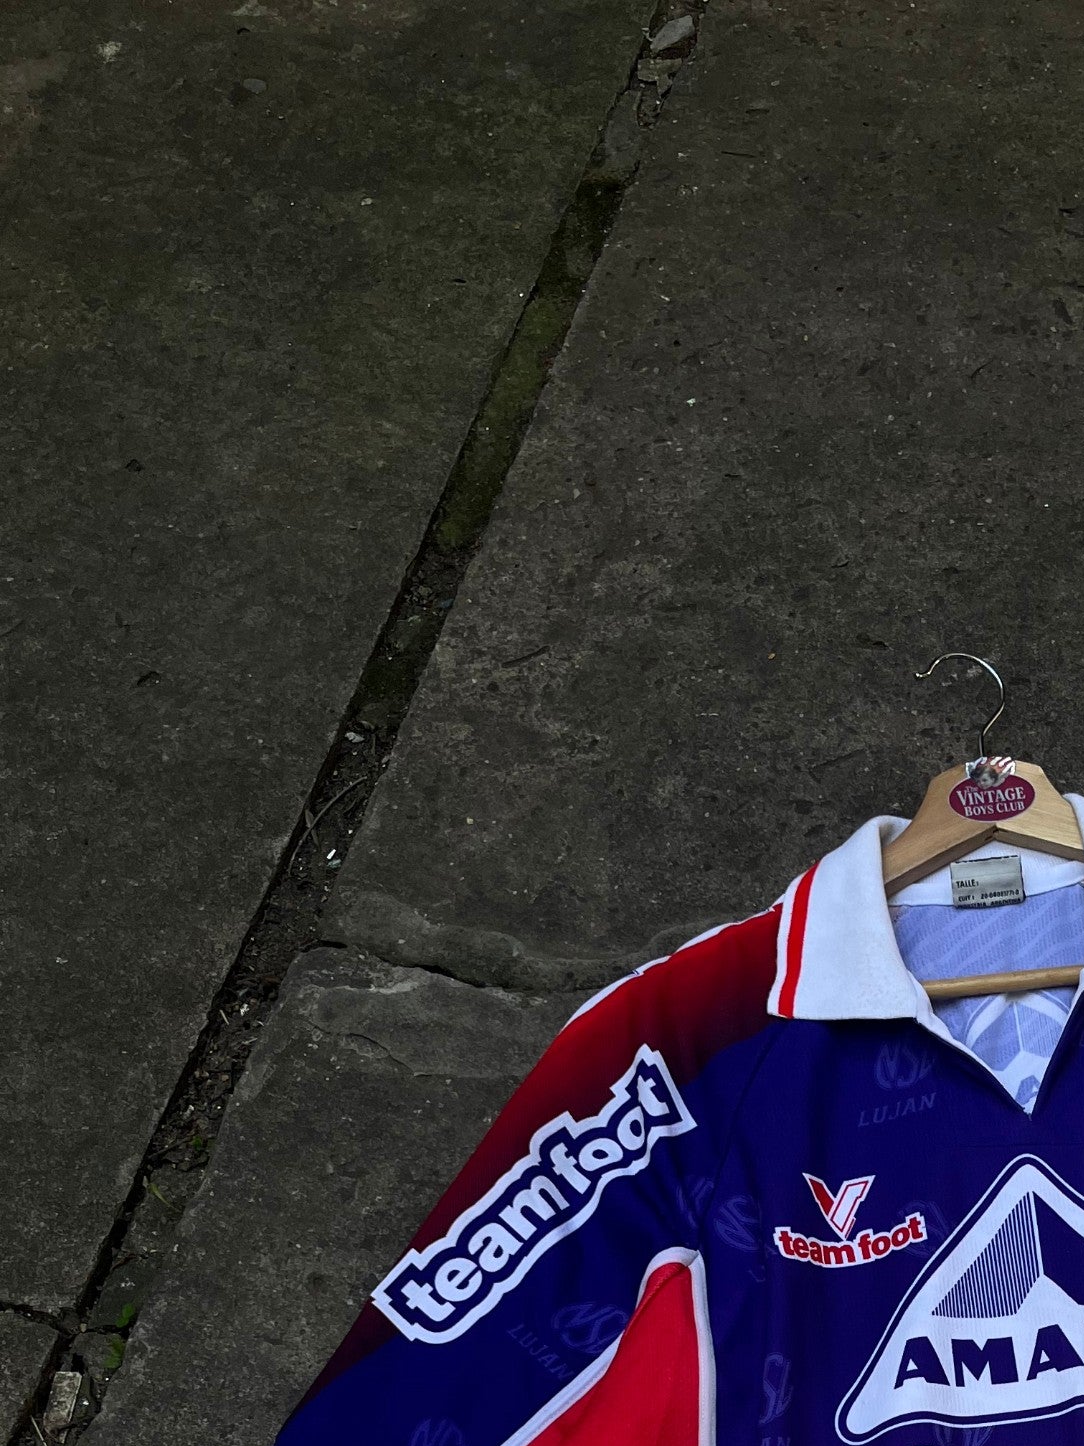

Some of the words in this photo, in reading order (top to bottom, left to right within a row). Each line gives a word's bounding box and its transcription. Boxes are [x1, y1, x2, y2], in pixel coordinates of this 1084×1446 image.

[956, 786, 1026, 807] VINTAGE
[964, 804, 995, 817] BOYS
[996, 801, 1025, 813] CLUB
[858, 1091, 937, 1128] LUJAN
[400, 1173, 571, 1323] team
[549, 1073, 670, 1197] foot
[778, 1230, 857, 1265] team
[858, 1216, 924, 1261] foot
